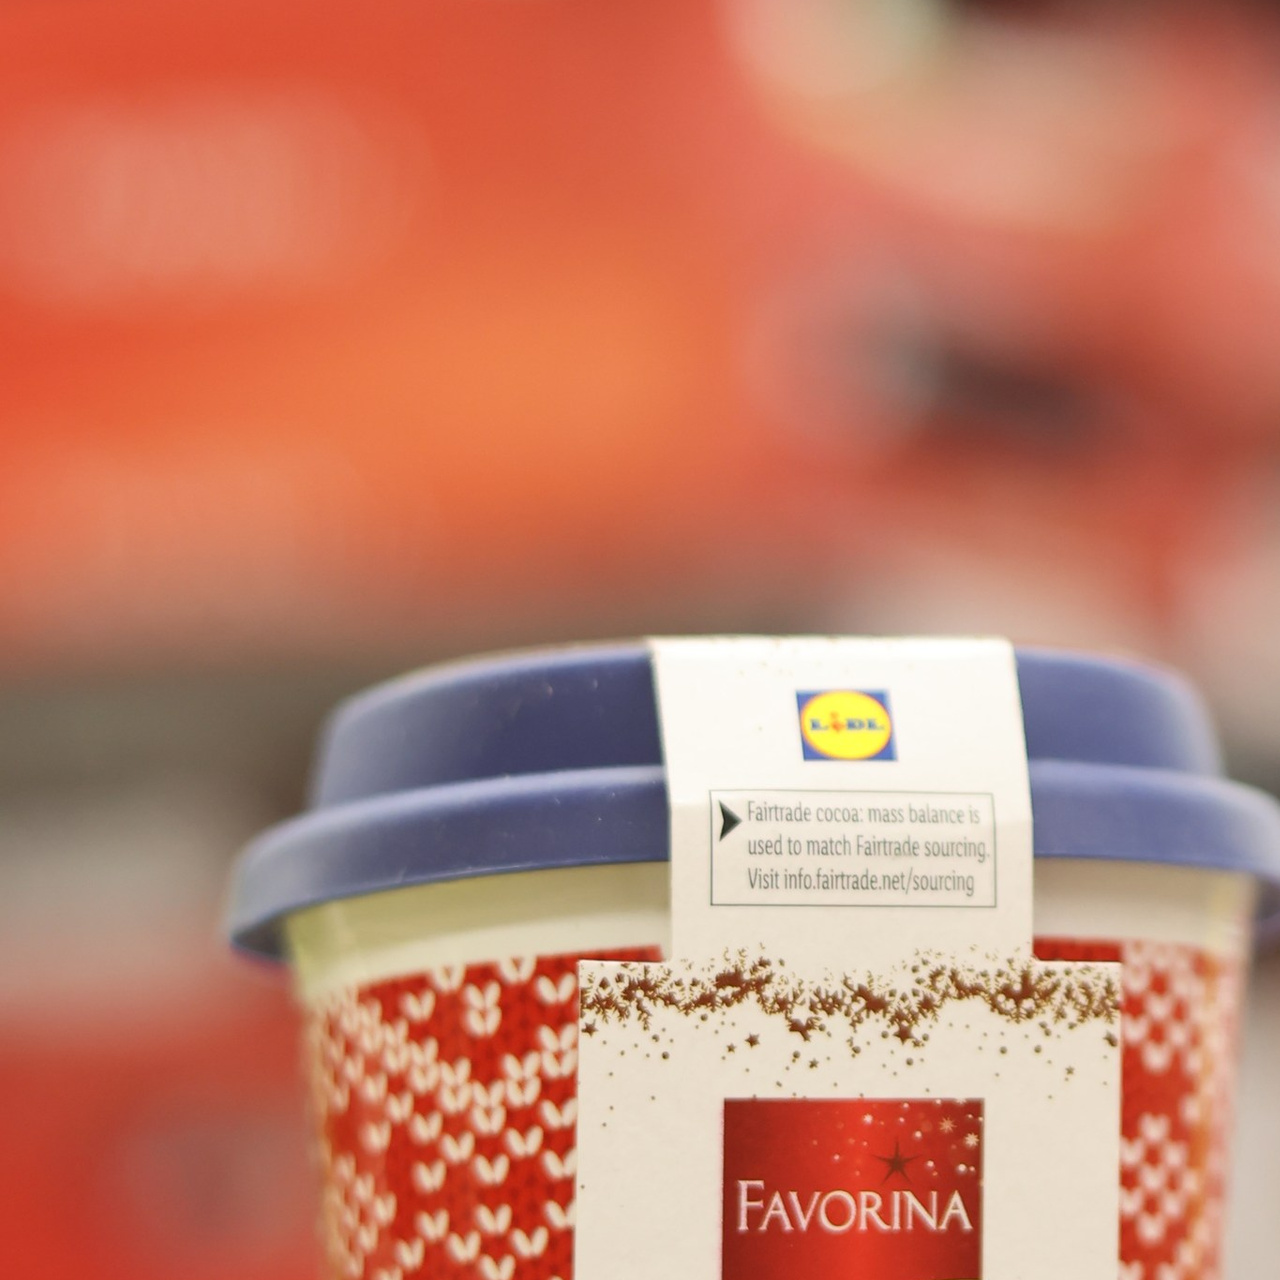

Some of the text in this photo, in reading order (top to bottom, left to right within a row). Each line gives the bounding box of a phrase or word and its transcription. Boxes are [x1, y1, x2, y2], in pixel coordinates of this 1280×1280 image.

[748, 800, 981, 825] Fairtrade cocoa: mass balance is
[748, 834, 991, 863] used to match Fairtrade sourcing.
[748, 867, 975, 897] Visit info.fairtrade.net/sourcing
[737, 1179, 973, 1232] FAVORINA
